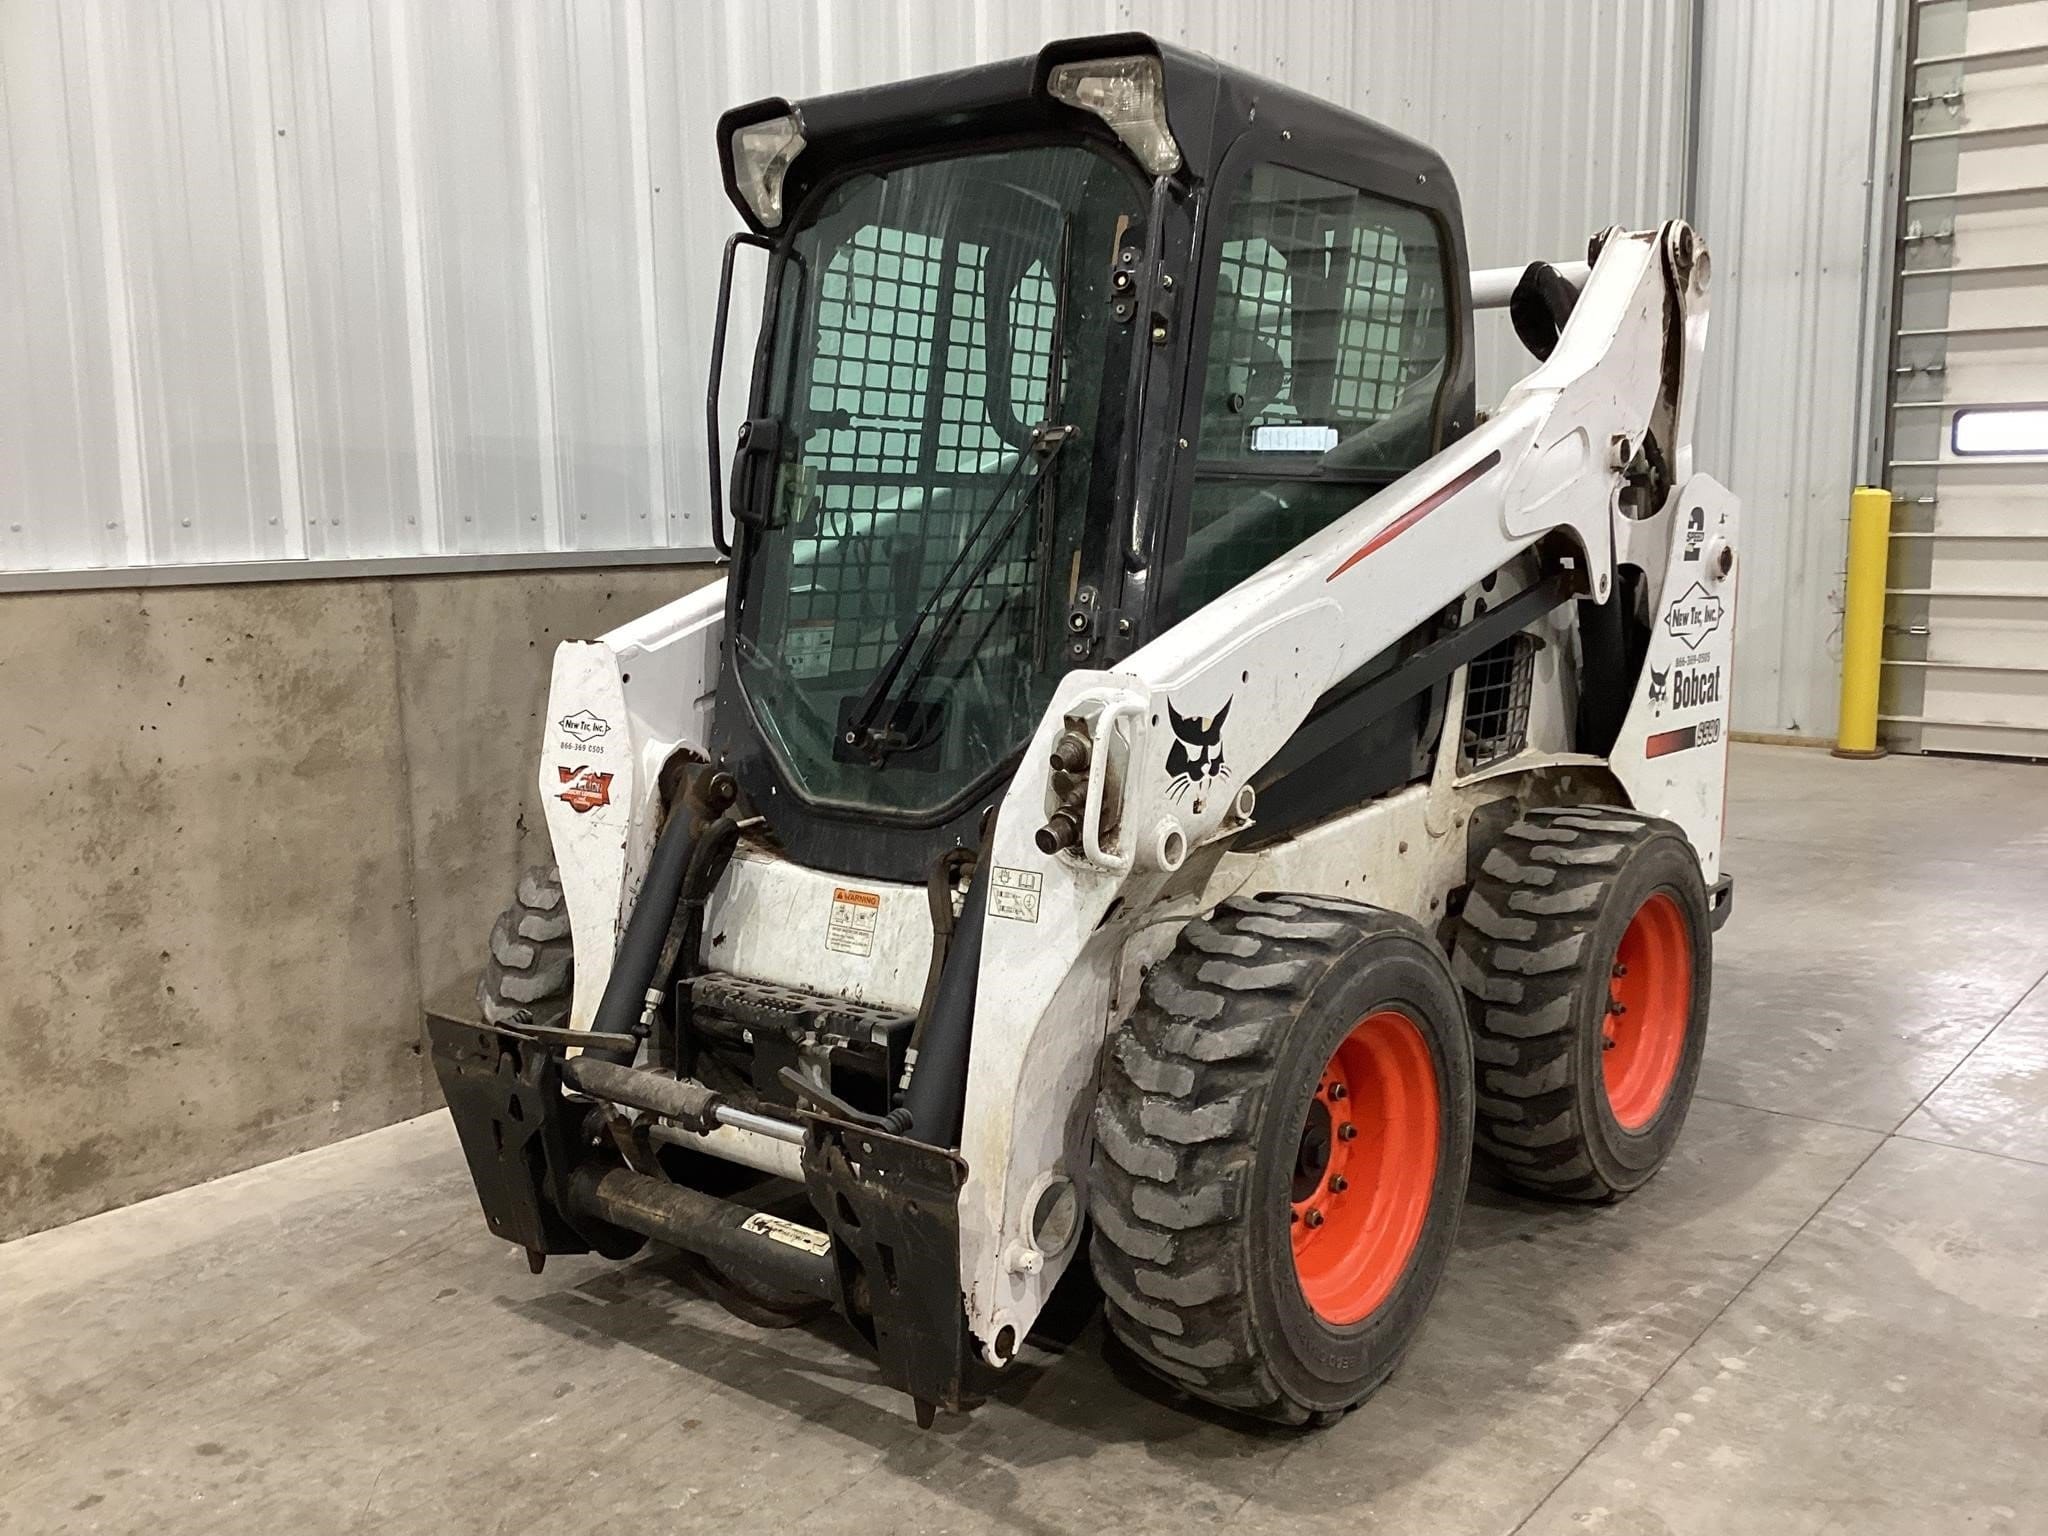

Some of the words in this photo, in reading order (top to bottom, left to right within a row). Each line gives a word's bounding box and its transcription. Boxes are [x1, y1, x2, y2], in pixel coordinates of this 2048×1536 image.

[1672, 608, 1690, 628] New
[1673, 665, 1720, 711] Bobcat
[565, 719, 579, 729] New
[844, 891, 876, 905] WARNING
